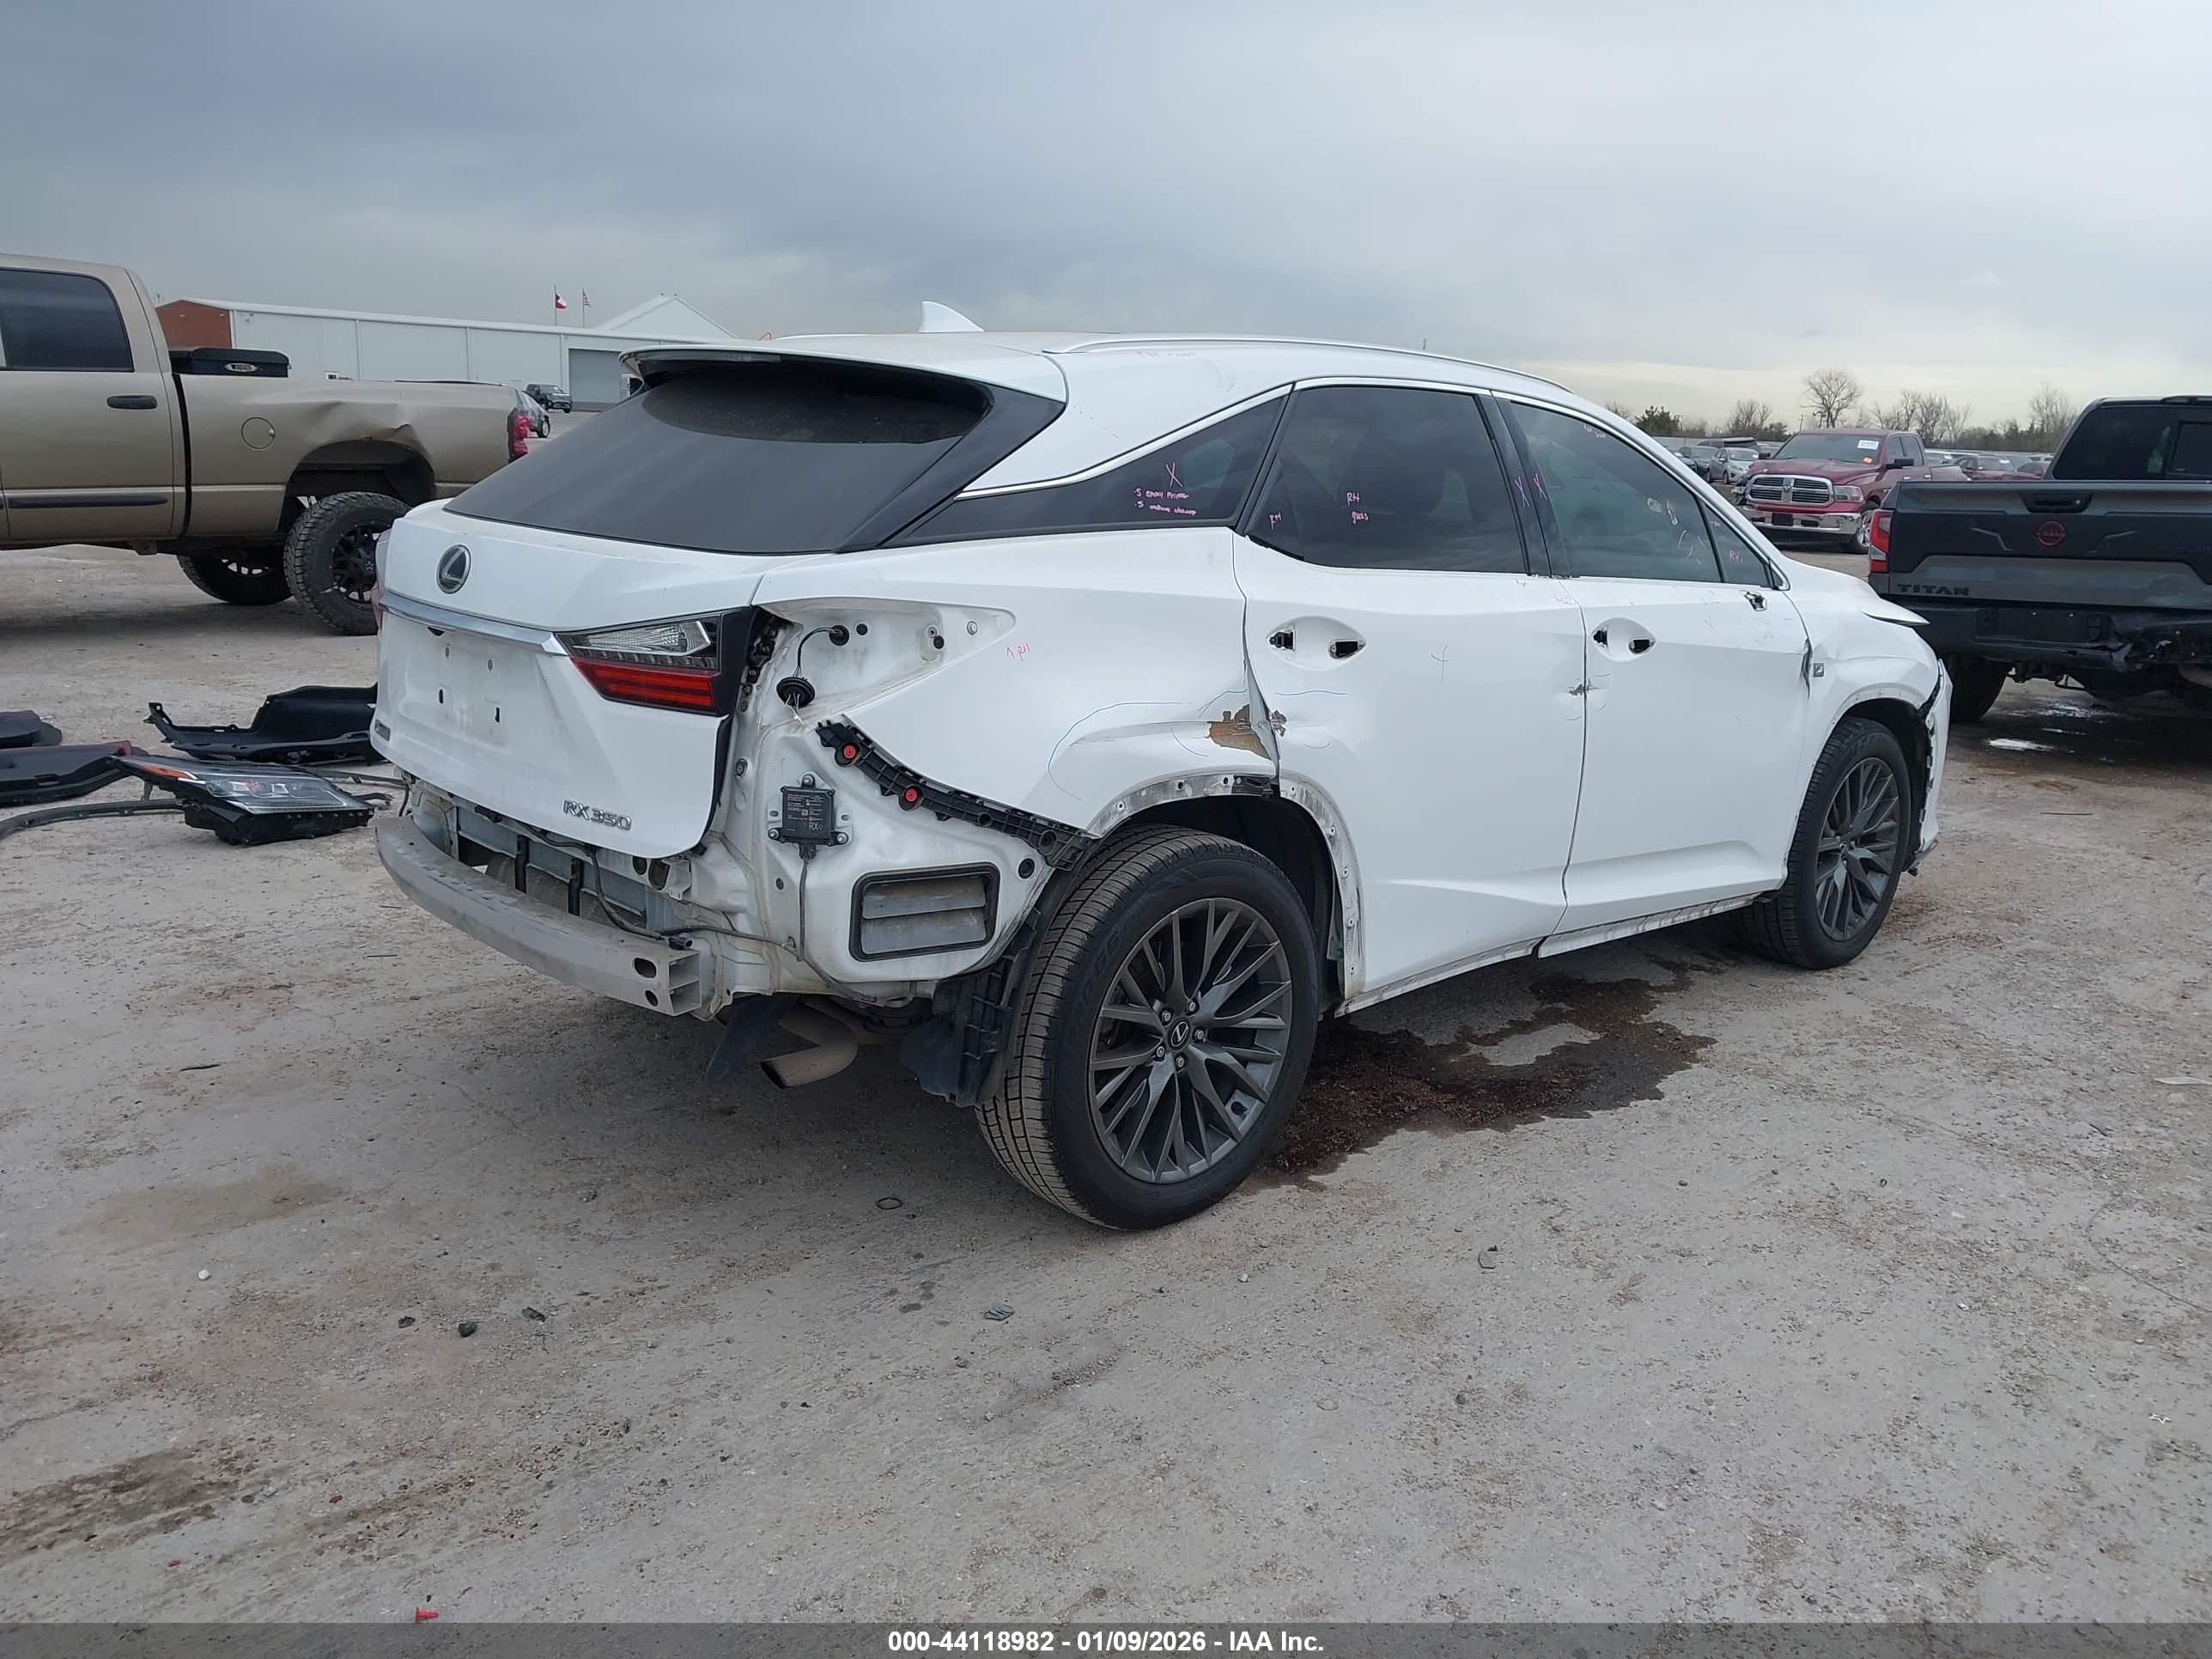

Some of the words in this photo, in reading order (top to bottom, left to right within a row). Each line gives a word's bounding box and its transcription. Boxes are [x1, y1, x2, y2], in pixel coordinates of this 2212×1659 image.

[1896, 584, 1970, 596] TITAN
[562, 799, 590, 821] RX
[590, 807, 632, 831] 350
